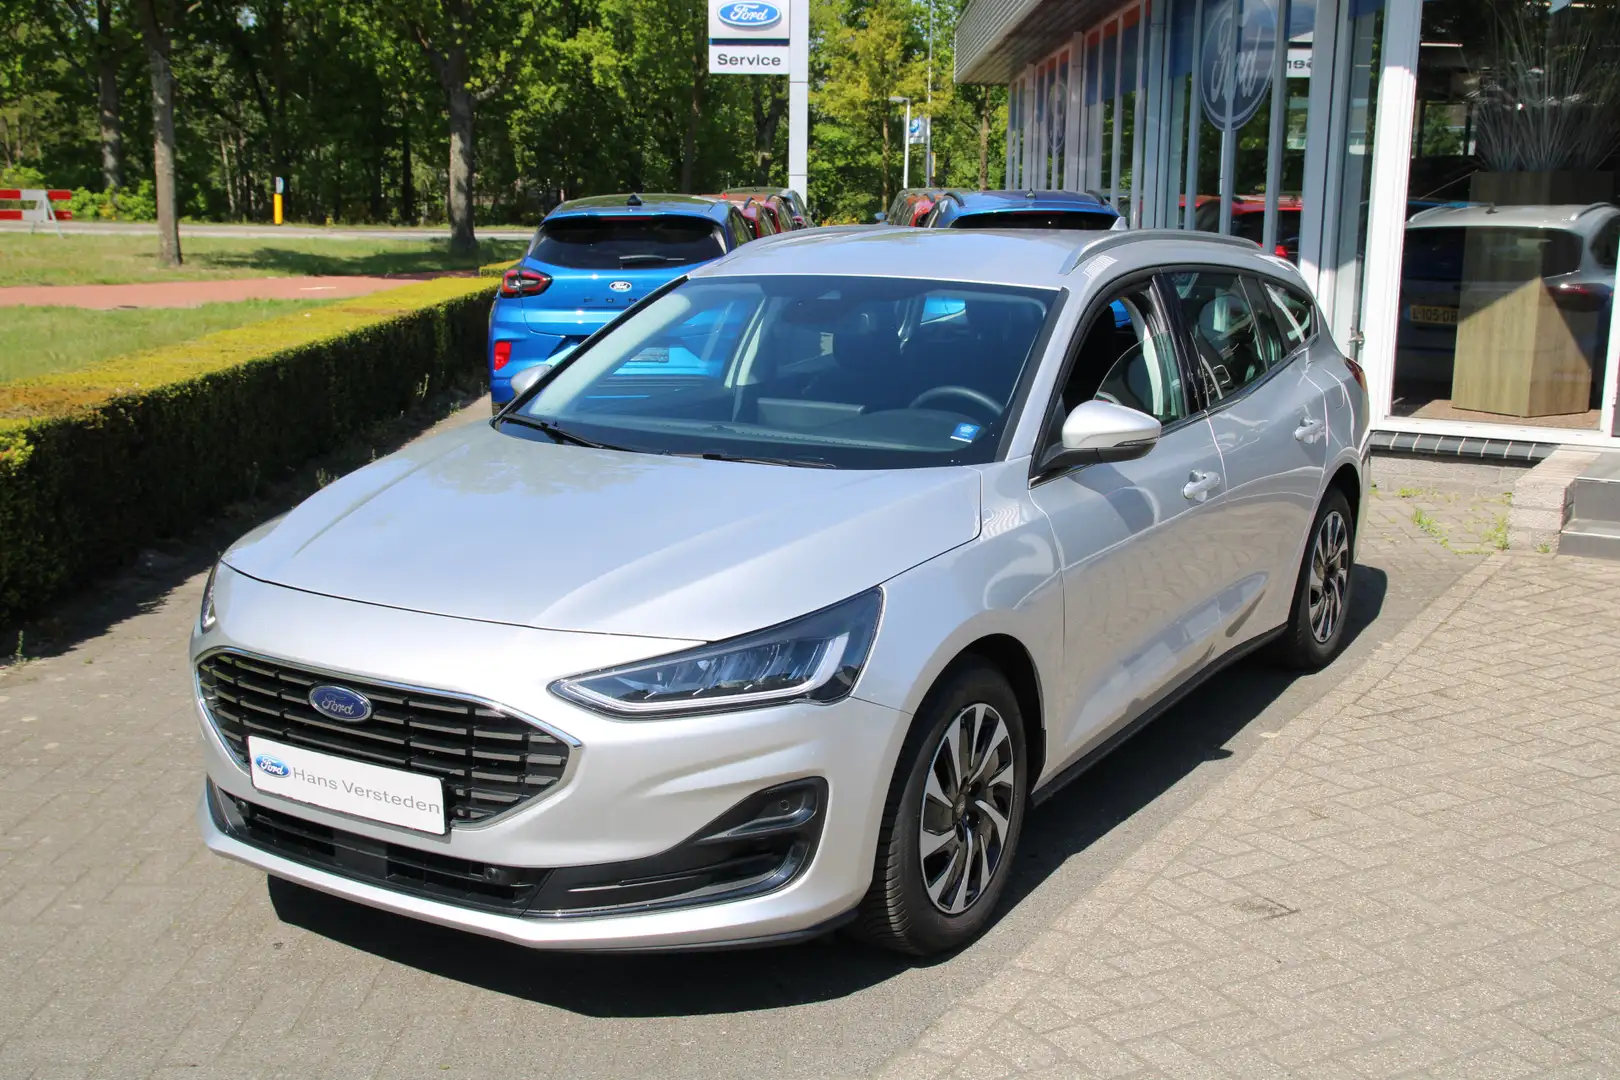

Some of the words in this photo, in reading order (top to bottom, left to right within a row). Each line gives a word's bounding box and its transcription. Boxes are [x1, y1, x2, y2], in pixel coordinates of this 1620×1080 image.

[729, 4, 769, 20] Ford
[717, 53, 781, 66] Service
[321, 692, 355, 715] Ford
[260, 758, 285, 775] Ford
[293, 767, 338, 790] Hans
[341, 779, 441, 815] Versteden
